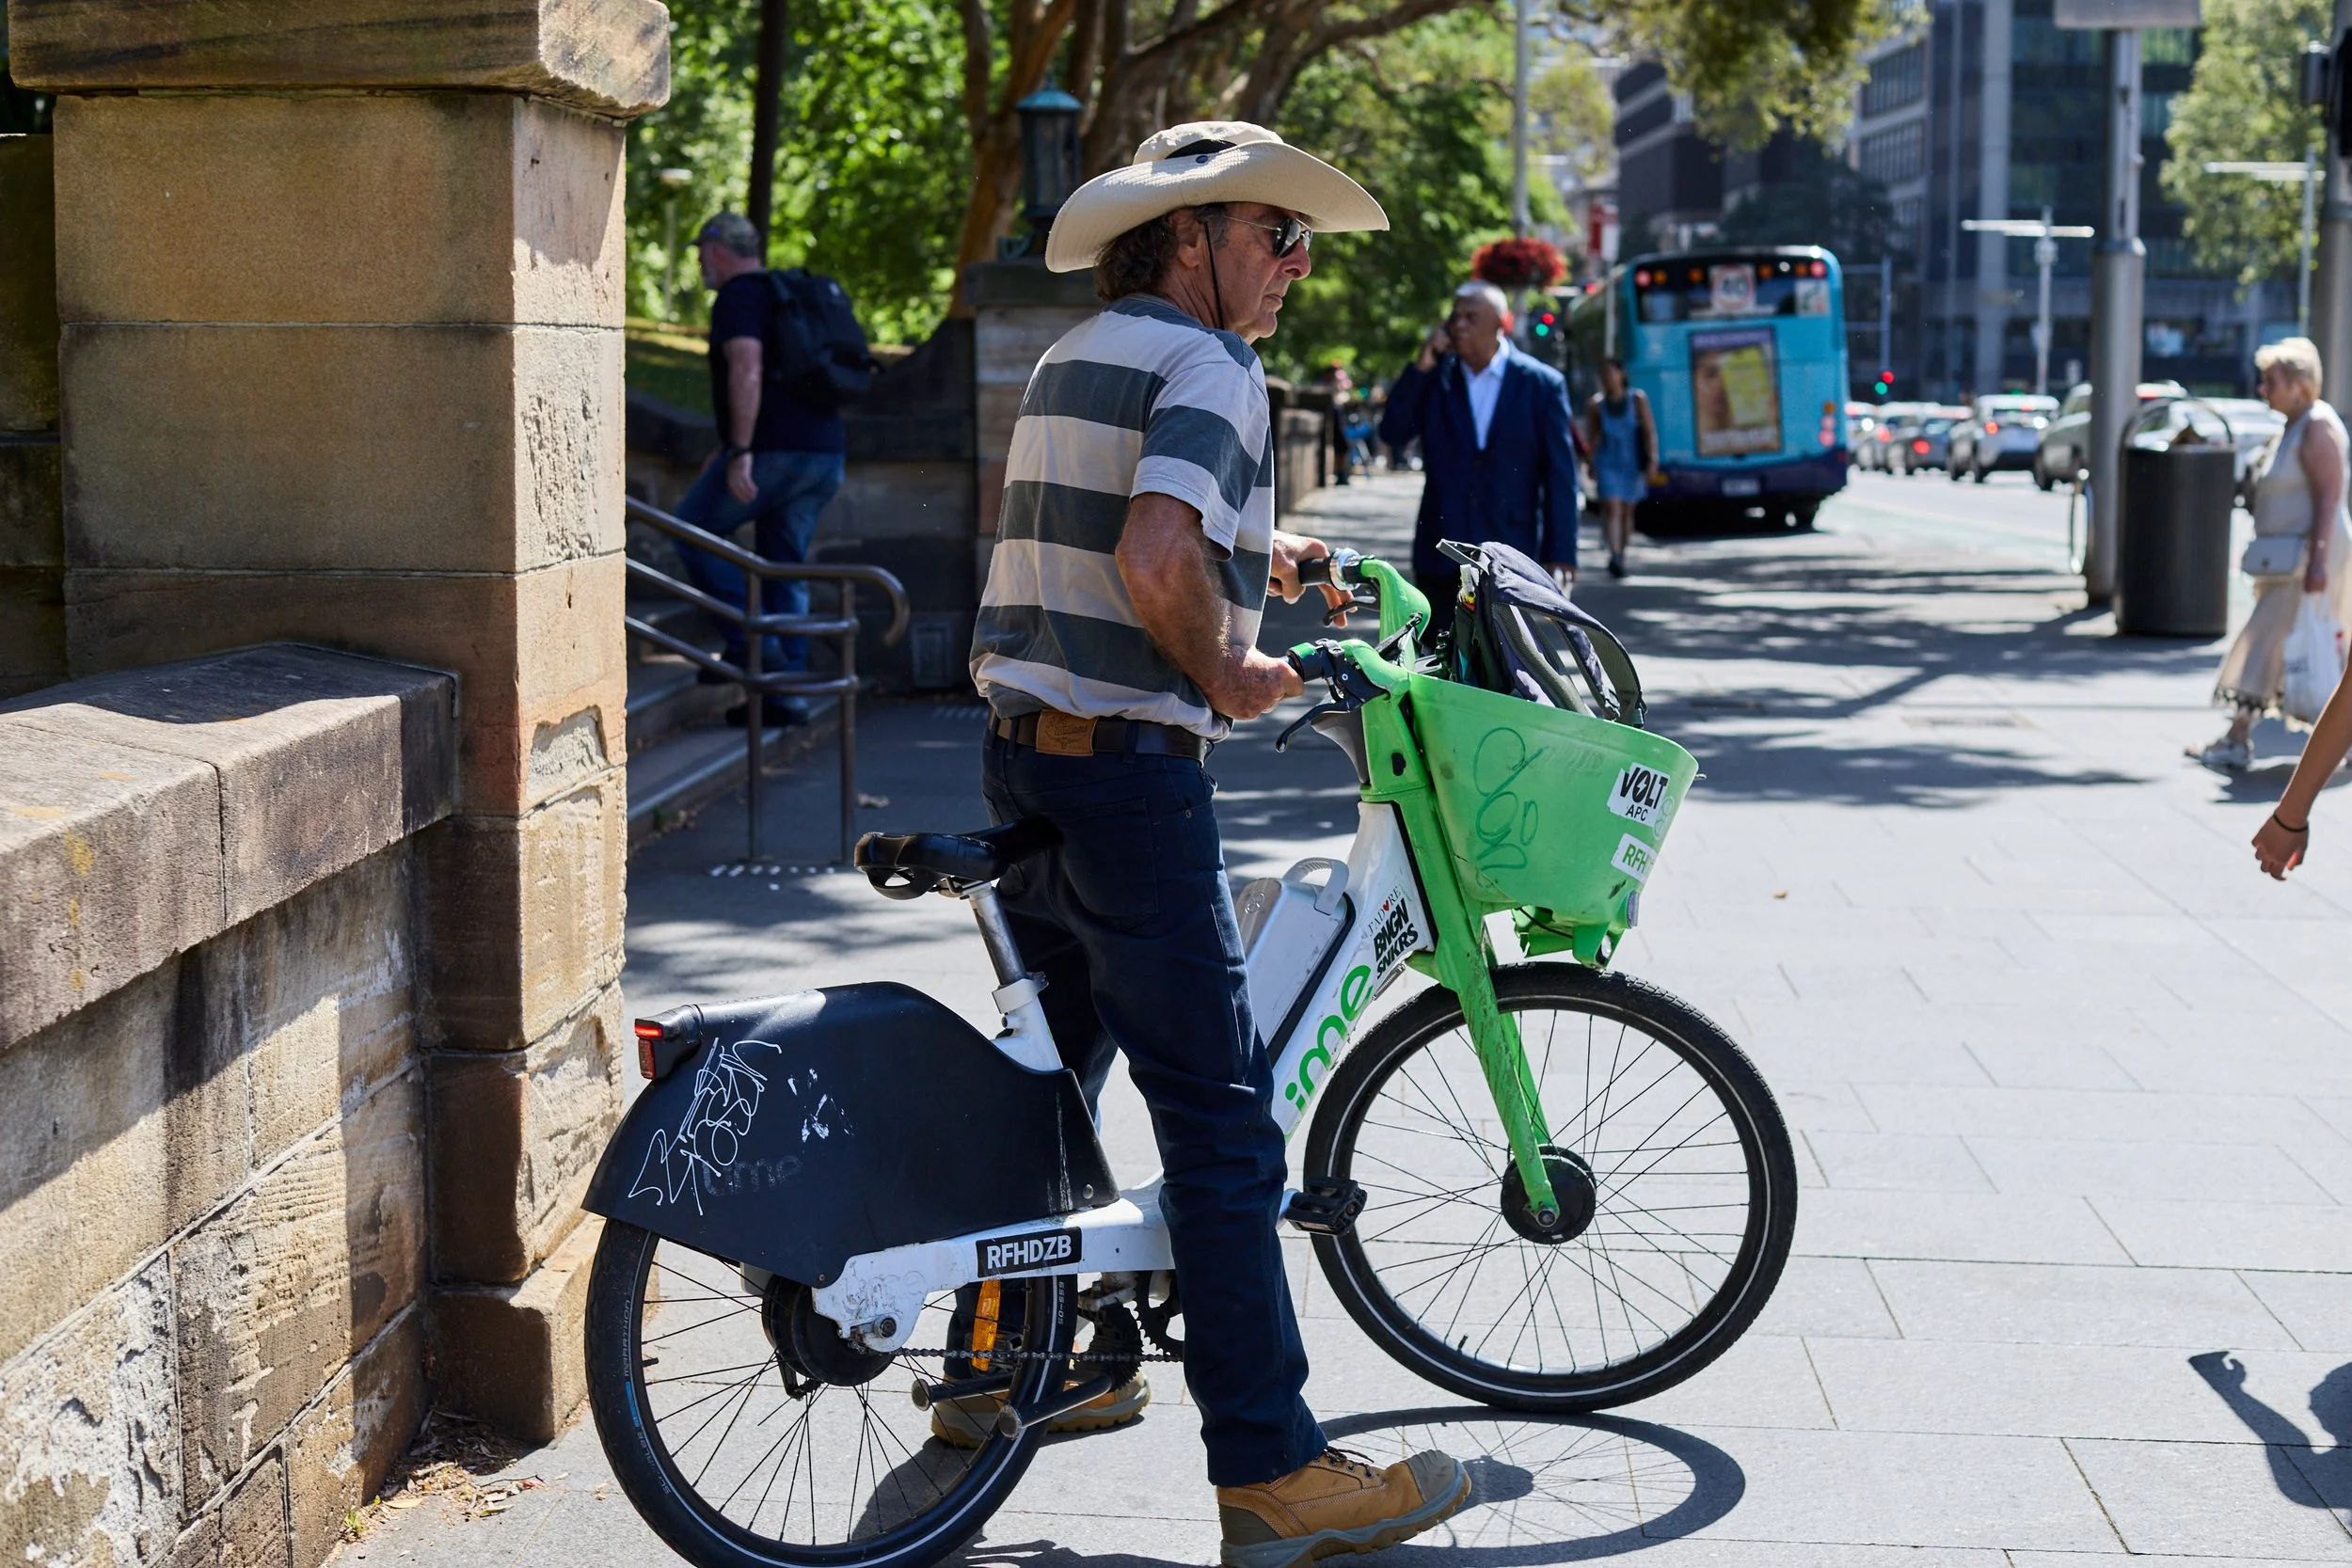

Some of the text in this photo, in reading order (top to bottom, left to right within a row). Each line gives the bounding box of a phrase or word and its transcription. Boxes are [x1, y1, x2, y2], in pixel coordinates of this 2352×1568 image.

[1620, 767, 1669, 810] VOLT
[1626, 804, 1648, 821] APC
[1376, 923, 1419, 980] SNKRS
[1284, 964, 1374, 1119] ime
[987, 1234, 1072, 1270] RFHDZB
